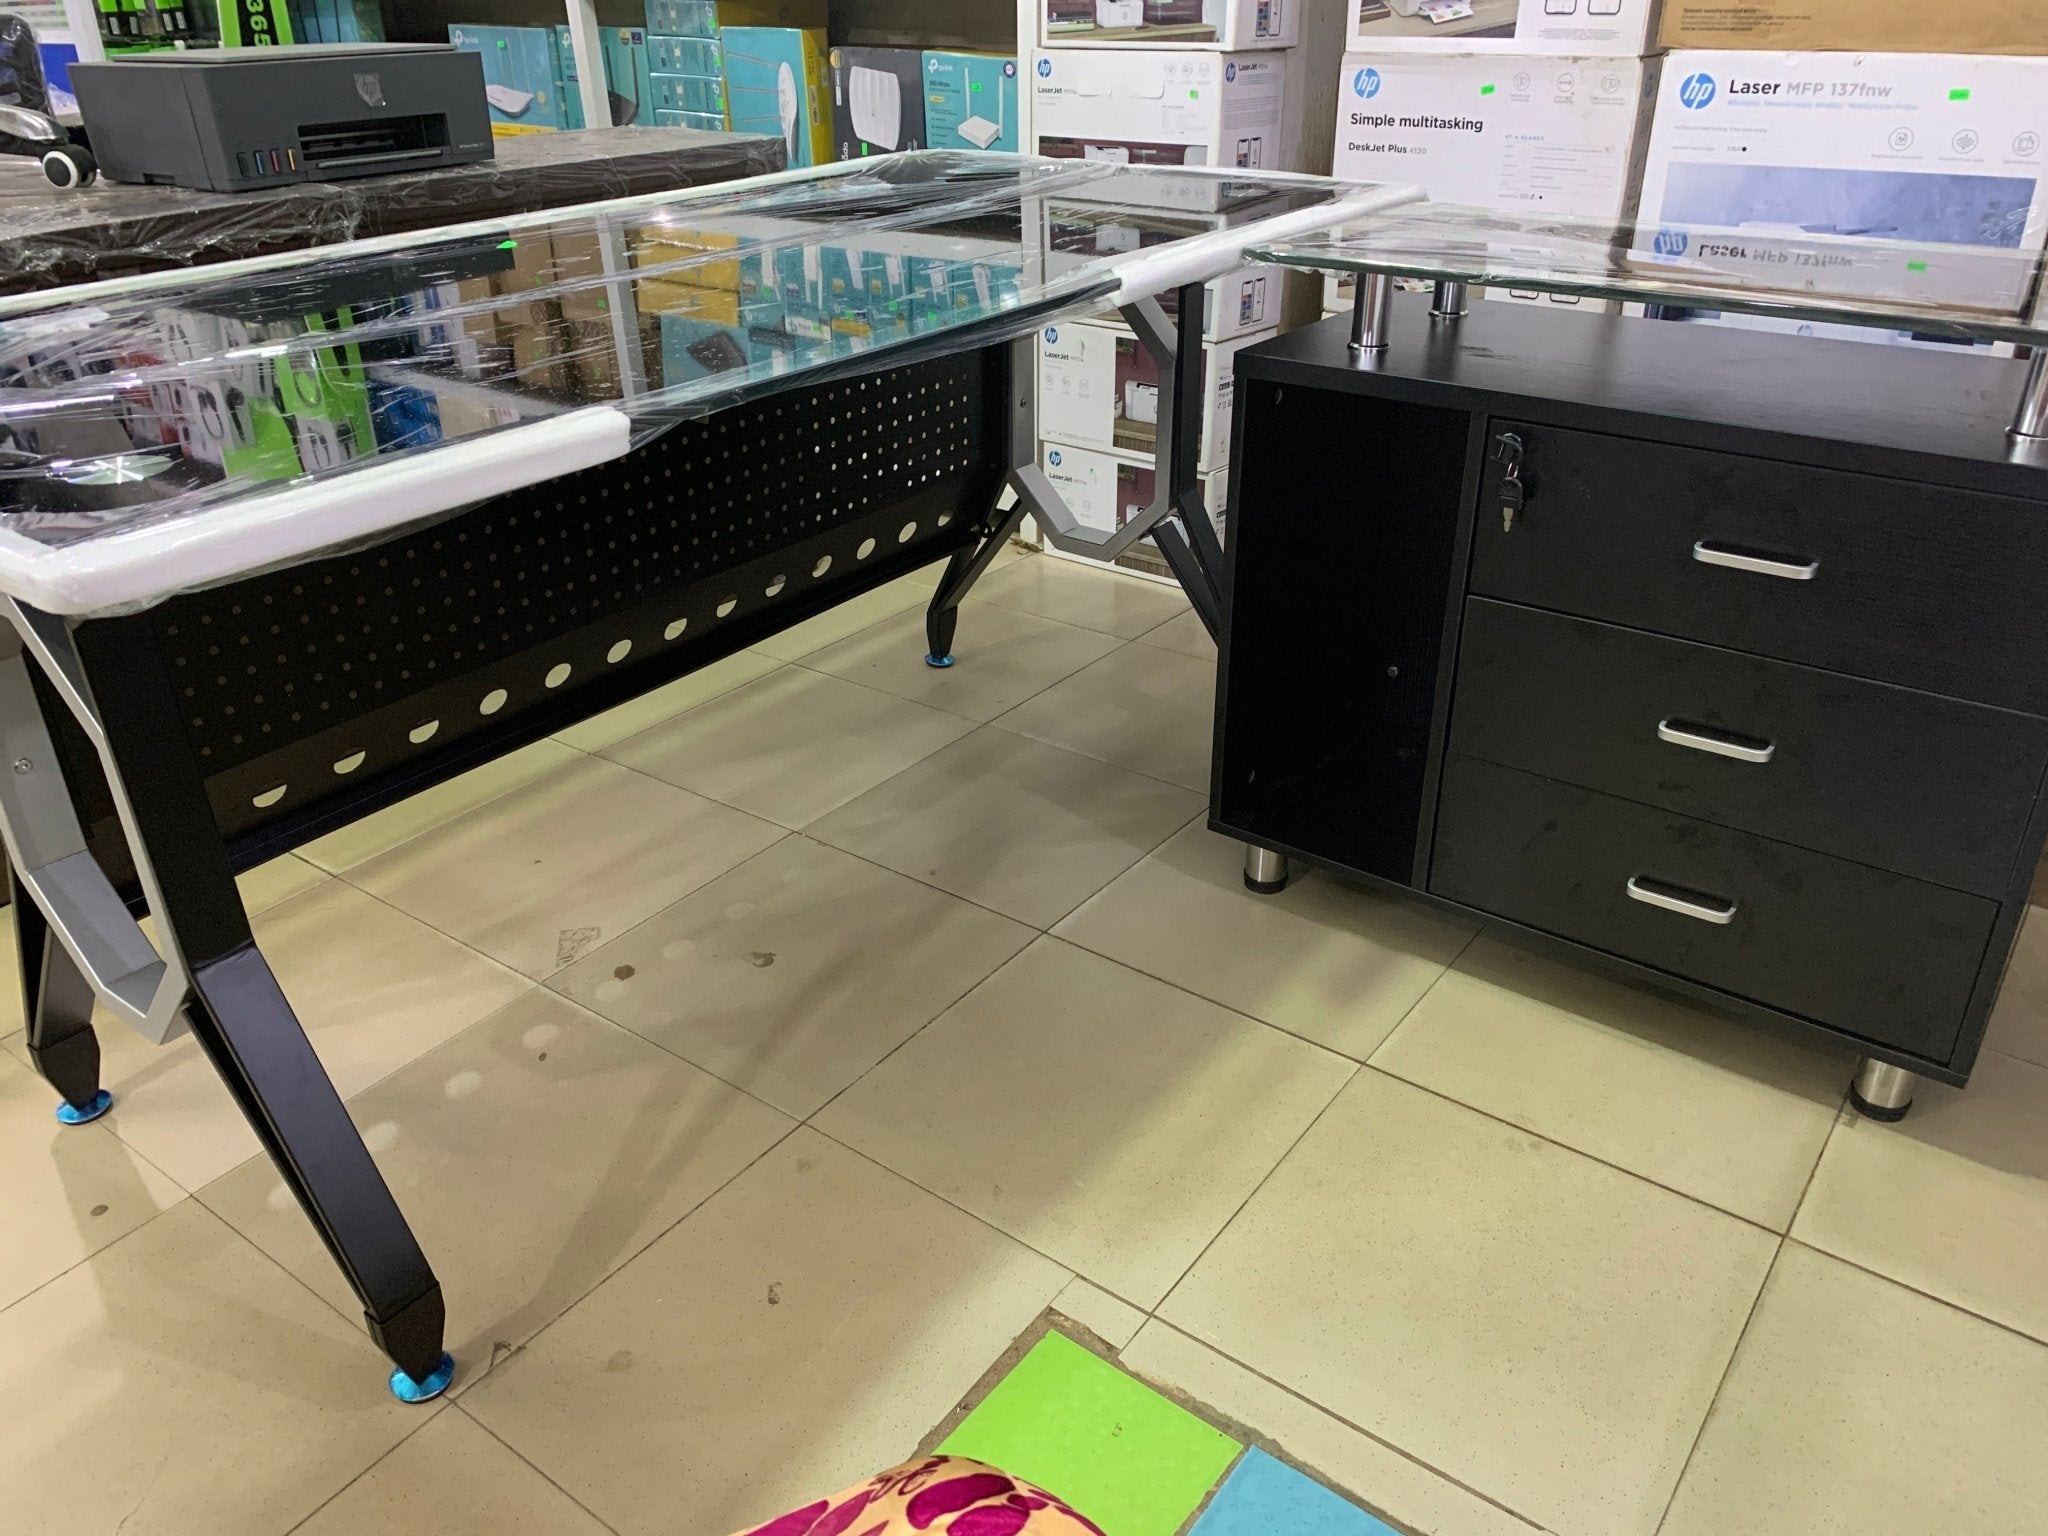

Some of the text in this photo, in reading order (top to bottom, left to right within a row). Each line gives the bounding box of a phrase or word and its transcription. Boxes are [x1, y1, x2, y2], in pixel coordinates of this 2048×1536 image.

[1038, 58, 1052, 78] hp
[1037, 86, 1063, 95] LaserJet
[1353, 67, 1381, 99] hp
[1680, 72, 1717, 110] hp
[1729, 79, 1893, 98] Laser MFP 137fnw
[1350, 113, 1484, 133] Simple multitasking
[1348, 142, 1386, 153] DeskJet
[1388, 144, 1408, 154] Plus
[1045, 326, 1058, 344] hp
[1044, 351, 1070, 361] LaserJet
[1049, 450, 1062, 467] hp
[1048, 473, 1073, 483] LaserJet
